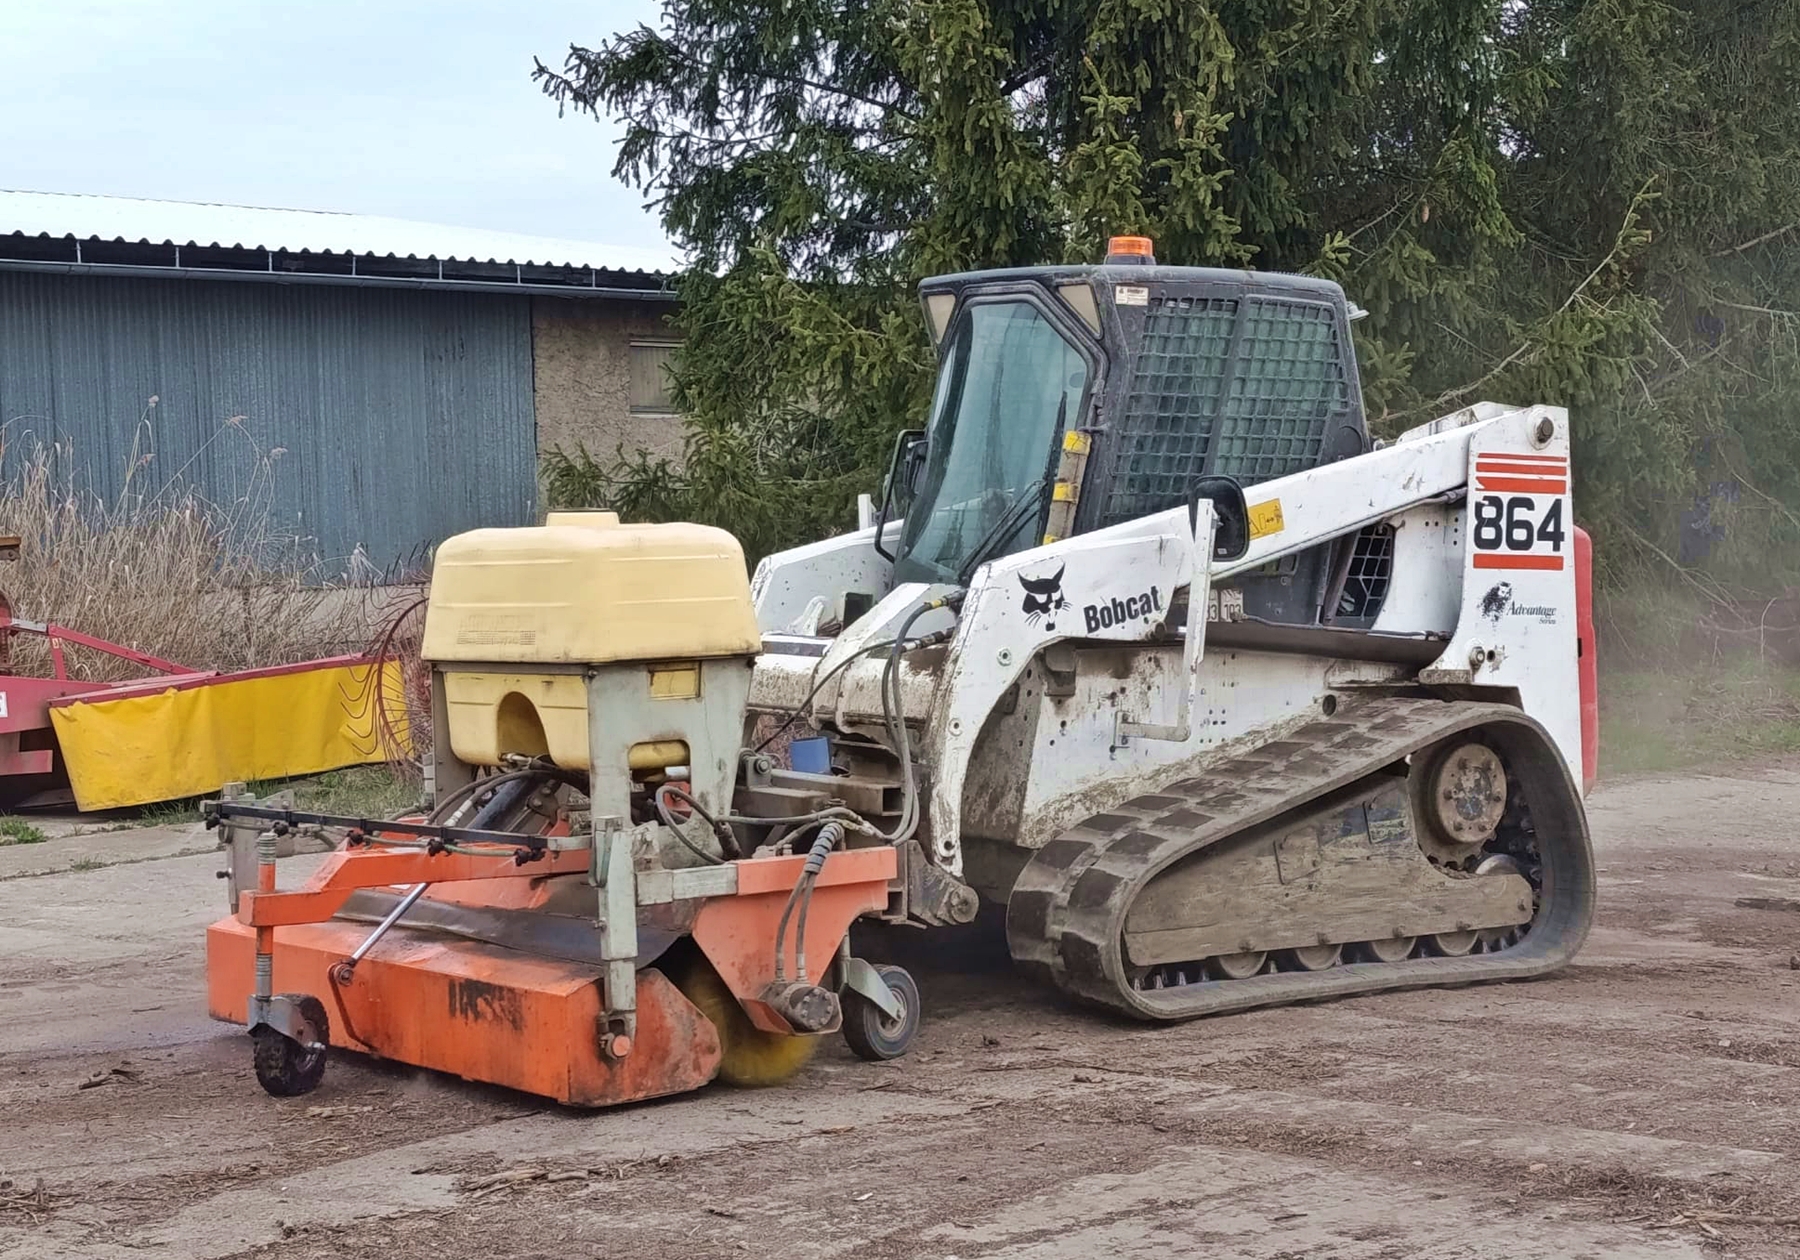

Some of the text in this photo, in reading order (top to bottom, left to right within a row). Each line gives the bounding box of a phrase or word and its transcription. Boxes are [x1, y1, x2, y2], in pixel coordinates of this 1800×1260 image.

[1474, 496, 1565, 552] 864
[1084, 586, 1161, 634] Bobcat
[1507, 600, 1557, 618] Advantage
